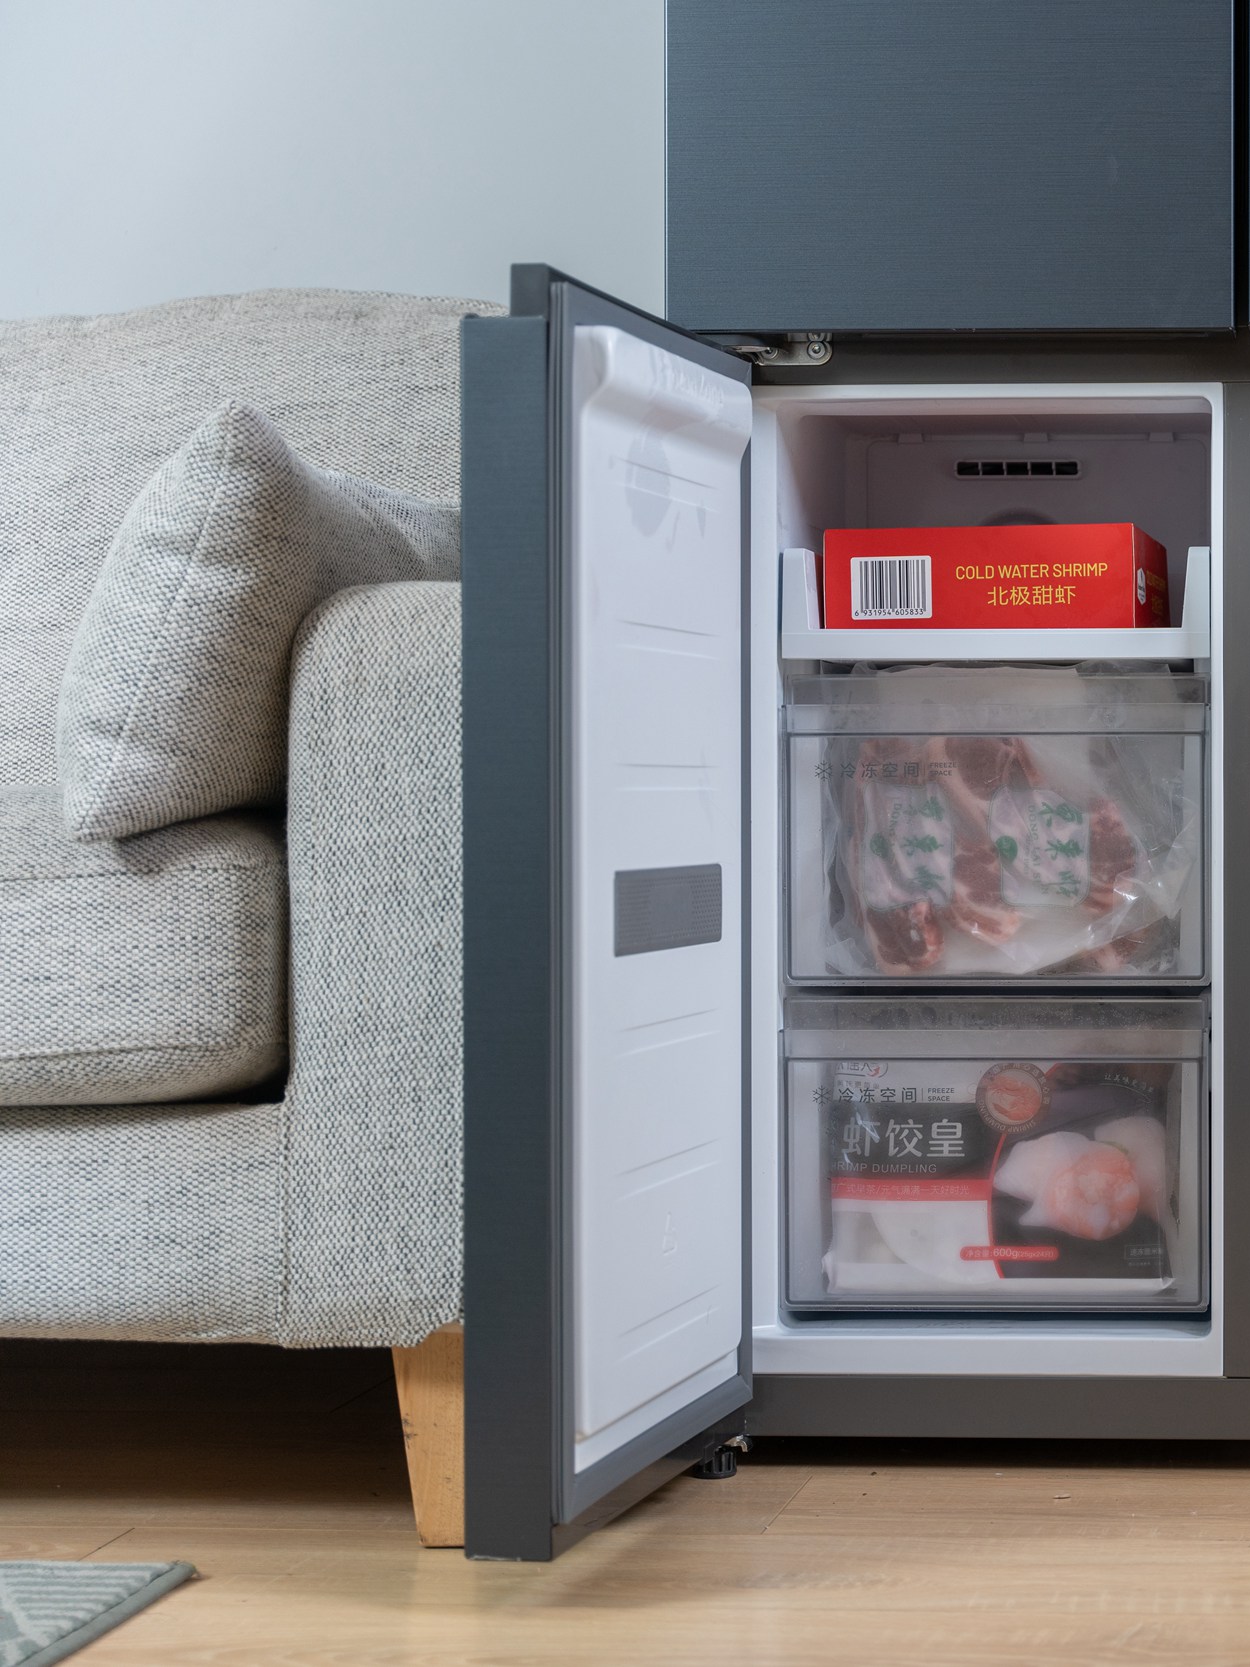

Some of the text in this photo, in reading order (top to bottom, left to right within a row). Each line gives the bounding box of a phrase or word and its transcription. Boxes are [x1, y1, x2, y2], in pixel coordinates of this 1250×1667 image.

[955, 563, 1108, 580] COLD WATER SHRIMP
[987, 585, 1076, 606] 北极甜虾
[863, 609, 892, 617] 931954
[895, 608, 924, 616] 605833
[840, 761, 920, 779] 冷冻空间
[929, 769, 953, 777] SPACE
[1028, 805, 1040, 840] DONG
[838, 1087, 917, 1104] 冷冻空间
[842, 1118, 966, 1159] 虾饺皇
[831, 1161, 937, 1174] HRIMP DUMPLING
